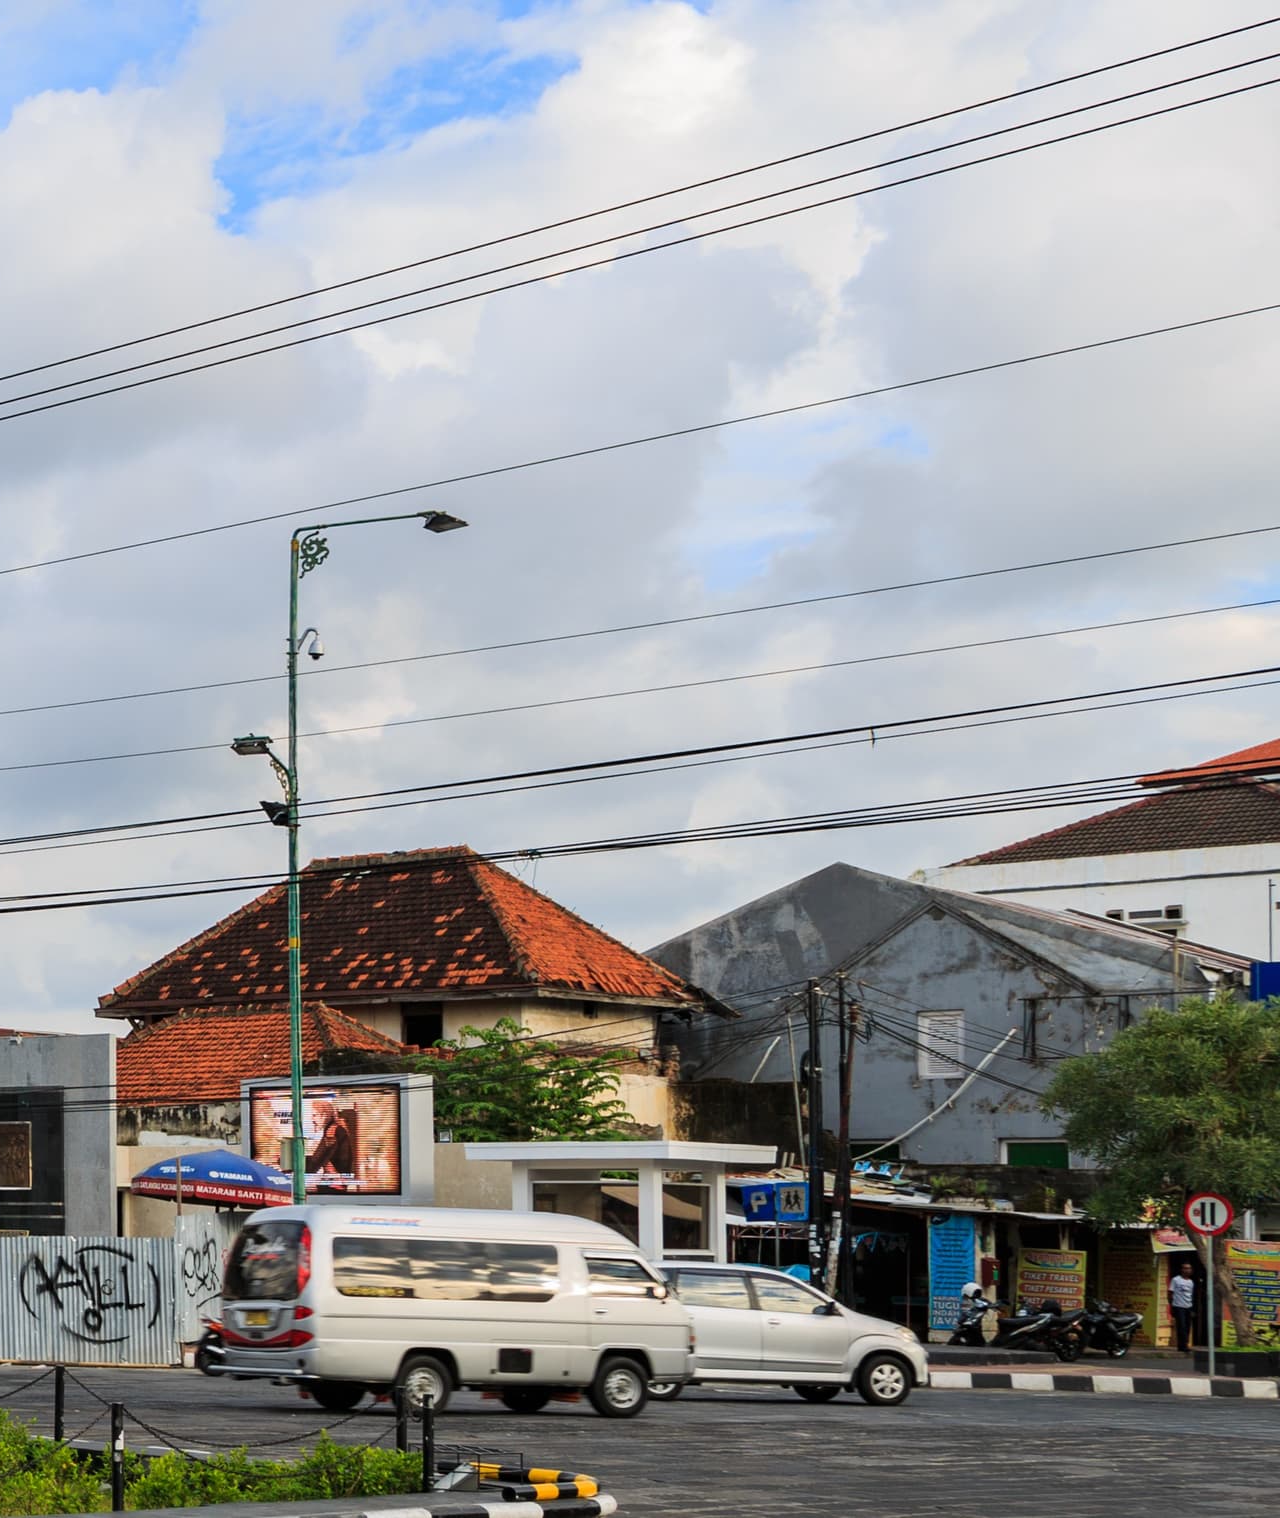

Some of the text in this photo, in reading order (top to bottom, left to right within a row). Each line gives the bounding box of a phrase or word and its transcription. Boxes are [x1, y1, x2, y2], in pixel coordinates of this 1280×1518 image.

[219, 1172, 254, 1182] YAMAHA
[196, 1185, 236, 1197] MATARAM
[238, 1190, 263, 1200] SAKTI
[1050, 1273, 1079, 1282] TRAVEL
[933, 1302, 960, 1310] TUGU
